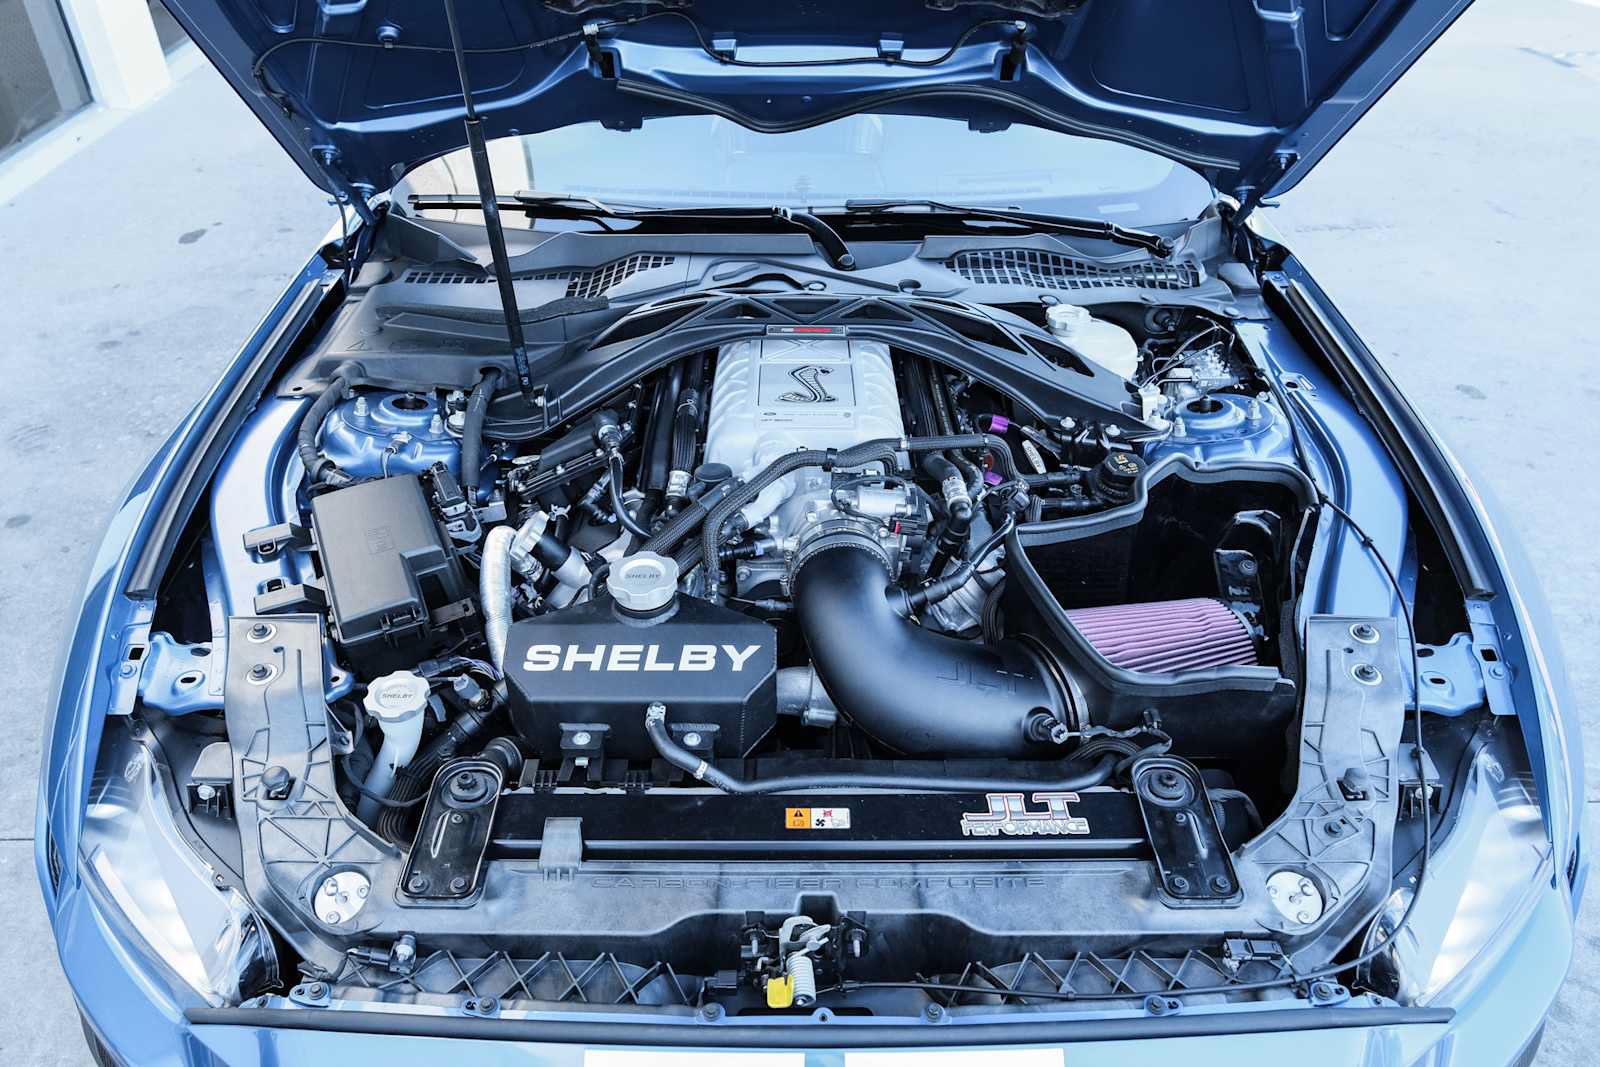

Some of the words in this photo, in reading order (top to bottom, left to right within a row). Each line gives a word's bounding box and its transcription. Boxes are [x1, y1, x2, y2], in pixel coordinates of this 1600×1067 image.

[624, 572, 662, 580] SHELBY
[522, 644, 762, 672] SHELBY
[381, 692, 414, 700] SHELBY
[962, 793, 1080, 821] JLT
[961, 818, 1090, 836] PERFORMANCE
